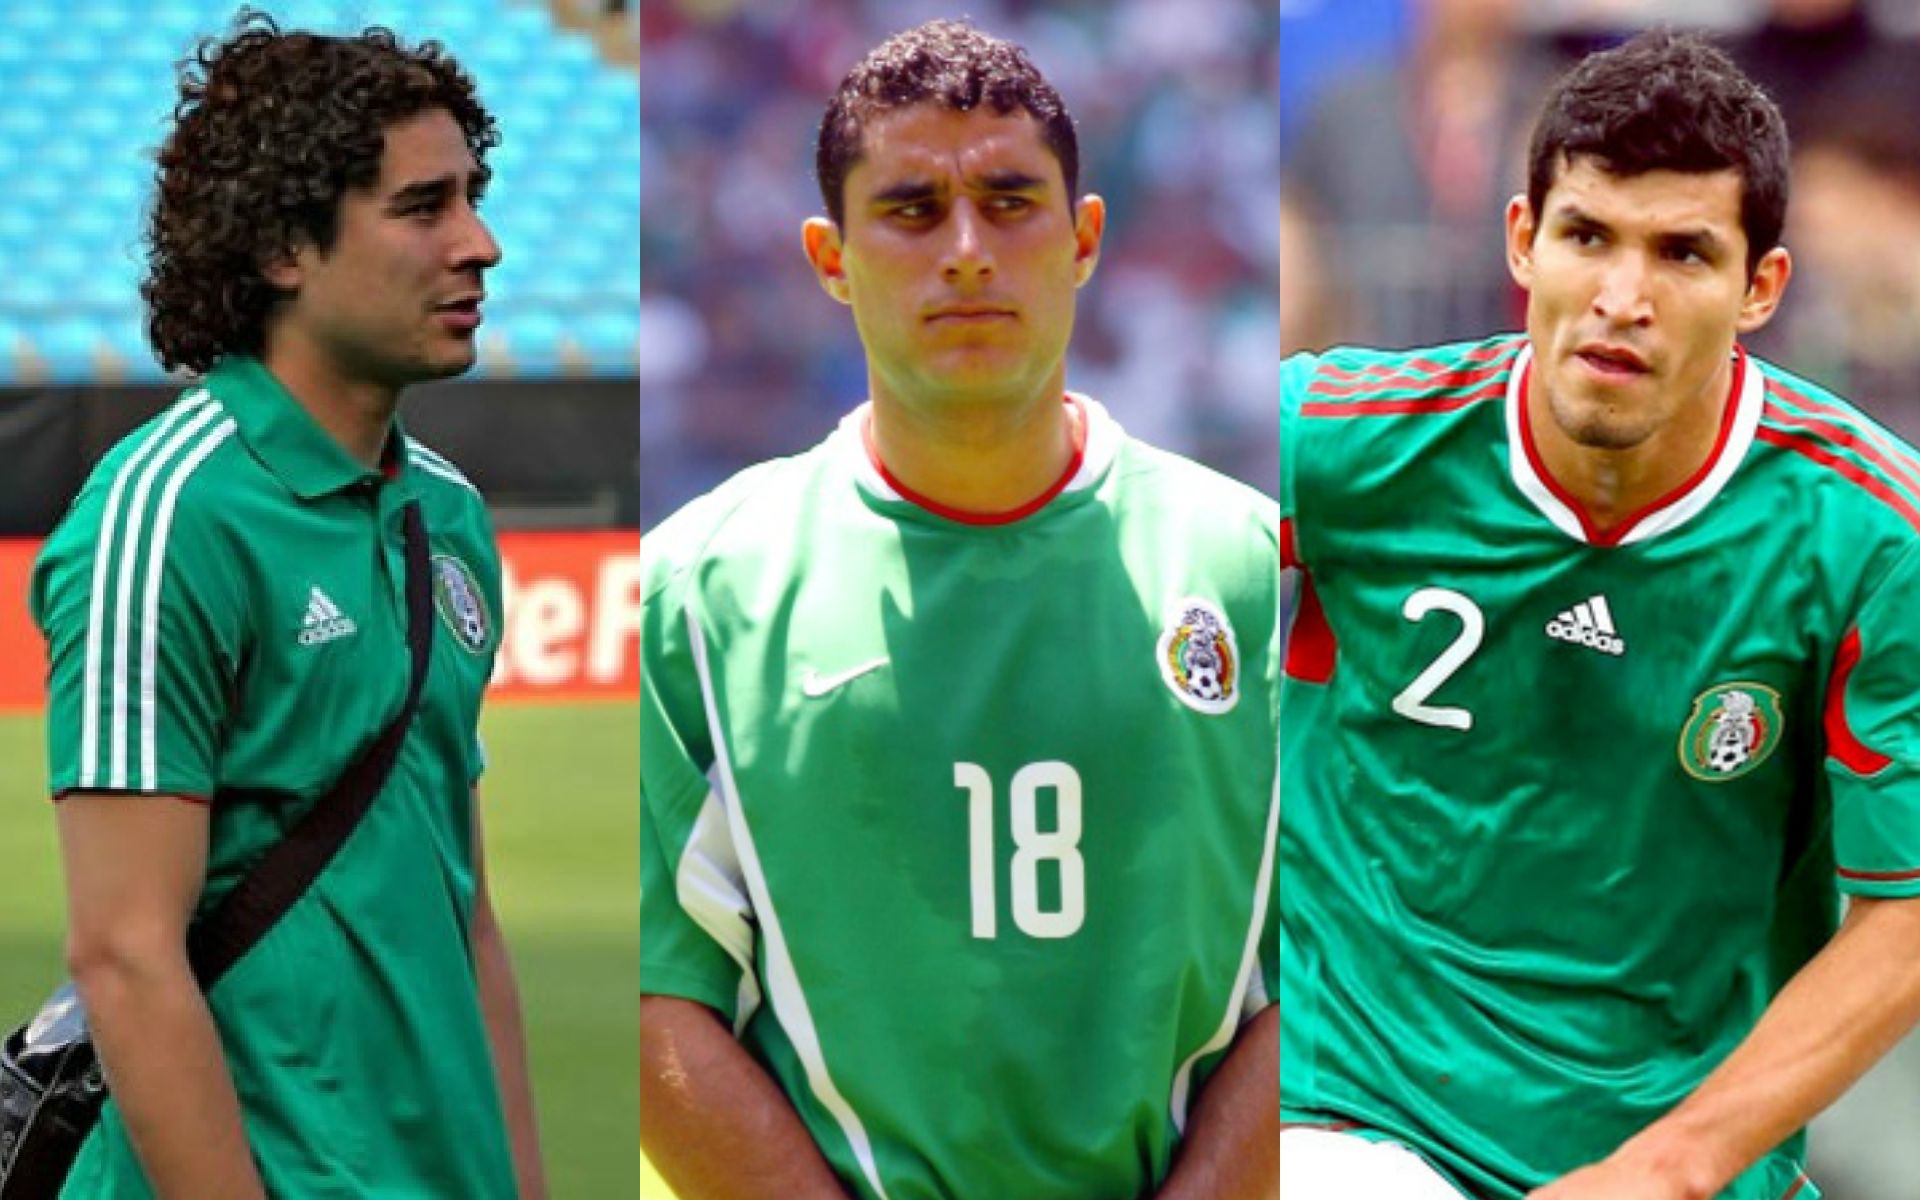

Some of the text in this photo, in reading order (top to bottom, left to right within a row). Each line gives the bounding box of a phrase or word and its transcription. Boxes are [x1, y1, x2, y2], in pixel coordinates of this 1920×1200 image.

[1392, 587, 1485, 731] 2
[1546, 620, 1625, 655] adidas
[953, 759, 1086, 940] 18
